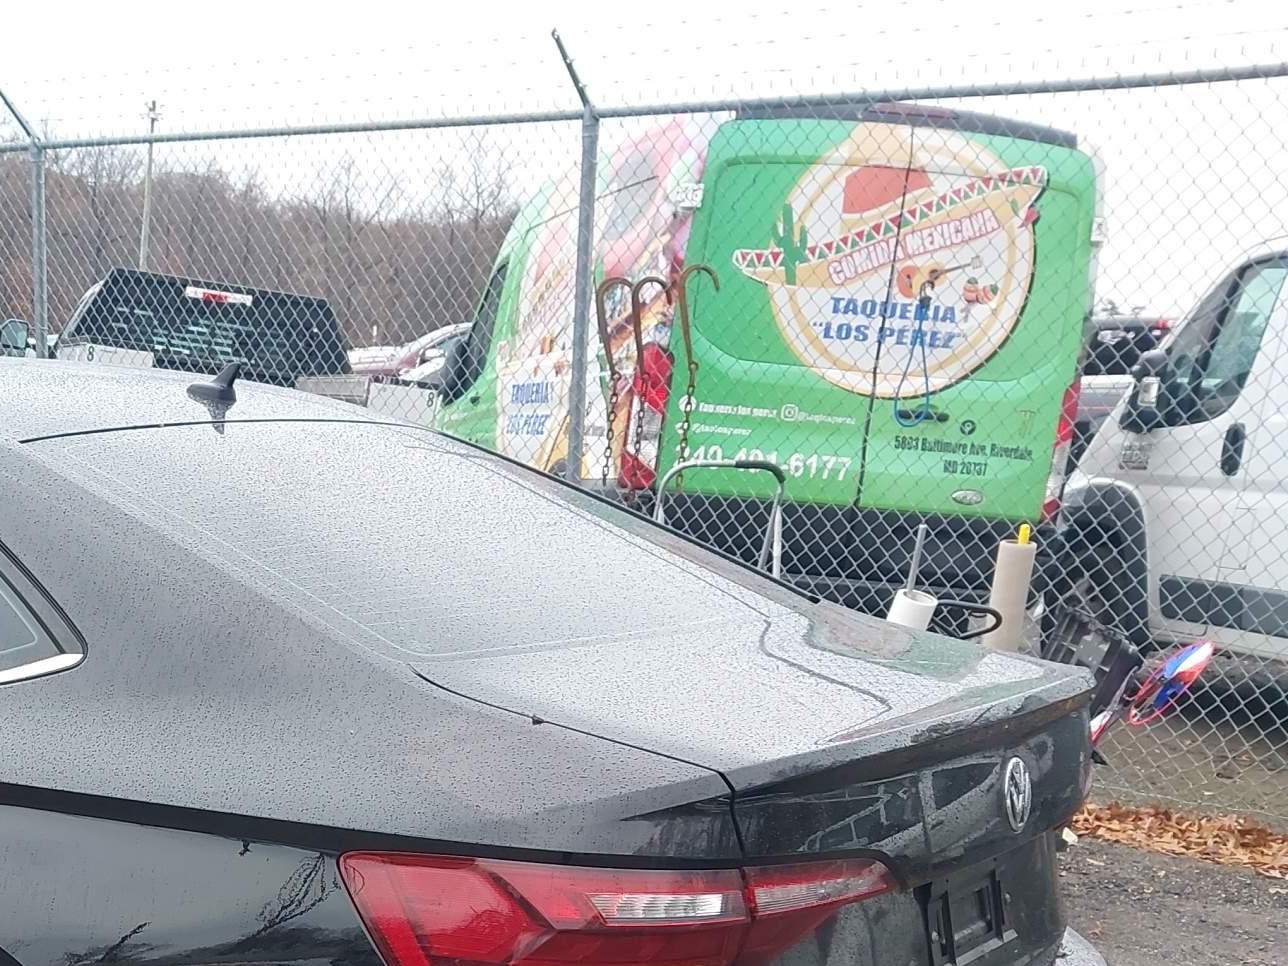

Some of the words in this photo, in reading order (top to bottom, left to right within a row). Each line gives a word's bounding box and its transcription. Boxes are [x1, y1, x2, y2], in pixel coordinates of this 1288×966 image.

[828, 238, 904, 285] COMIDA
[905, 208, 1001, 256] MEXICANA
[830, 296, 957, 324] TAQUERIA
